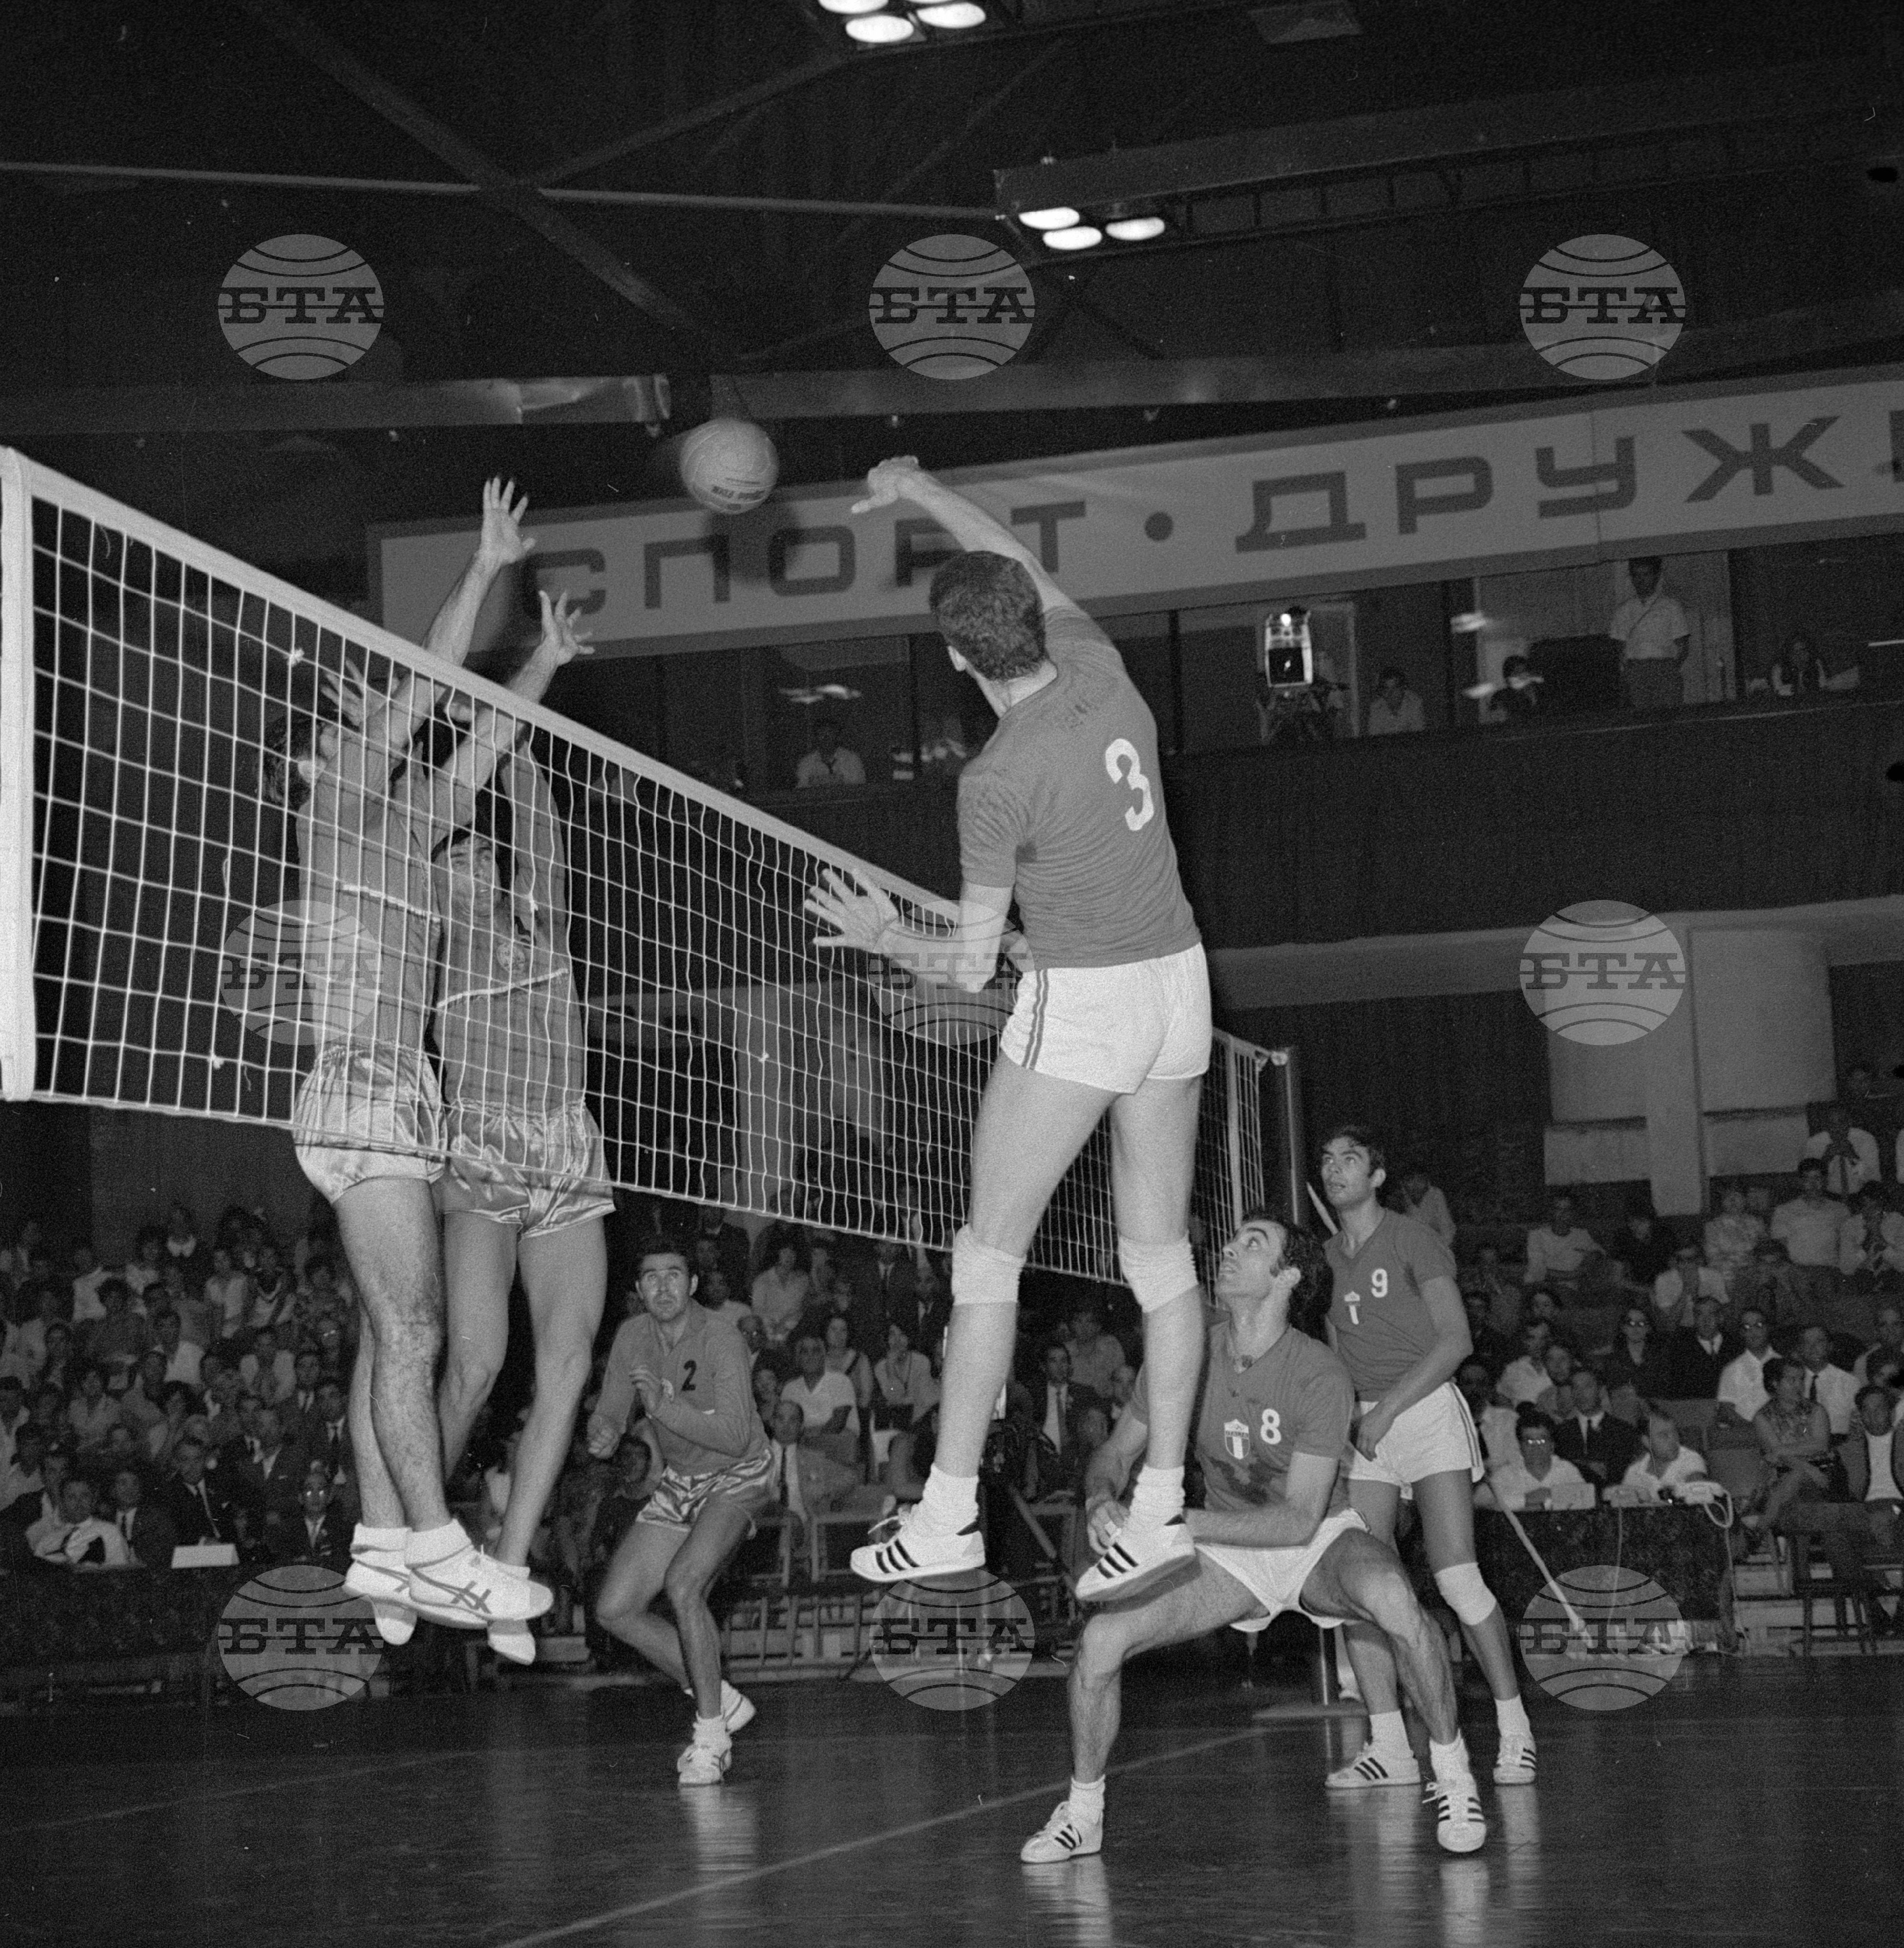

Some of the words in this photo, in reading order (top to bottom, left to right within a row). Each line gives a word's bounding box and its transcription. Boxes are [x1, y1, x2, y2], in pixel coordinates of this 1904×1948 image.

[1234, 410, 1904, 554] ДРУЖ
[524, 500, 1086, 617] СПОРТ
[1105, 738, 1154, 831] 3
[1371, 1269, 1388, 1298] 9
[681, 1359, 697, 1391] 2
[1260, 1408, 1281, 1445] 8
